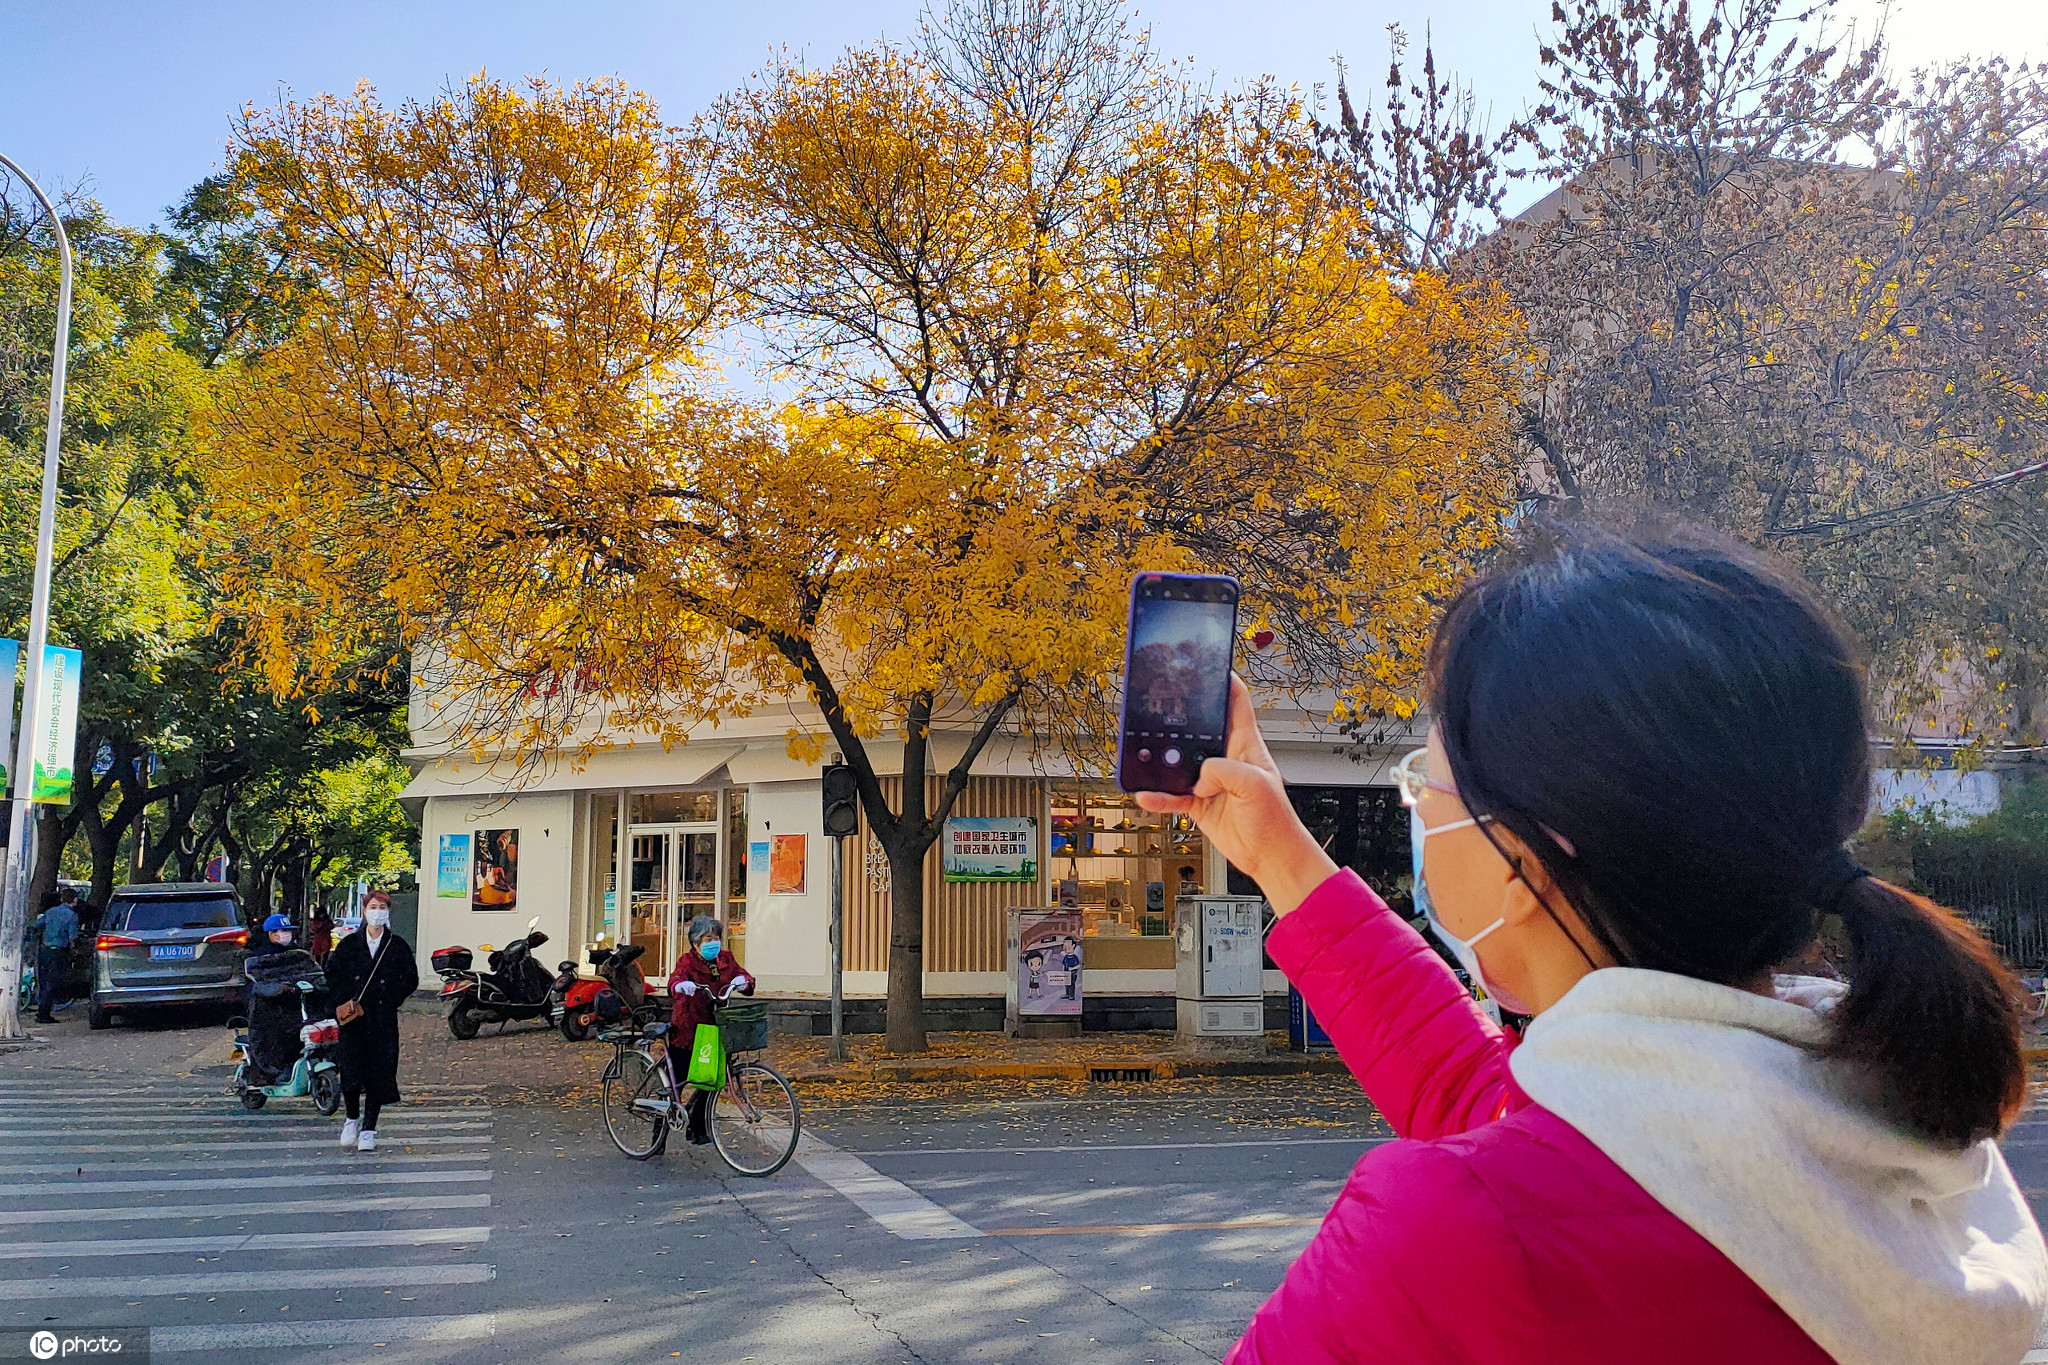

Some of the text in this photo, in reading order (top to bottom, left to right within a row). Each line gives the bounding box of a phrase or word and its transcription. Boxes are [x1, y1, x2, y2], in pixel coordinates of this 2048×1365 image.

[45, 654, 65, 778] 建设现代省会经济强市
[953, 831, 1027, 842] 创建国家卫生城市
[953, 844, 1027, 854] 彻底改善人居环境
[866, 853, 890, 864] BREA
[866, 867, 890, 878] PAST
[870, 882, 891, 892] CAF
